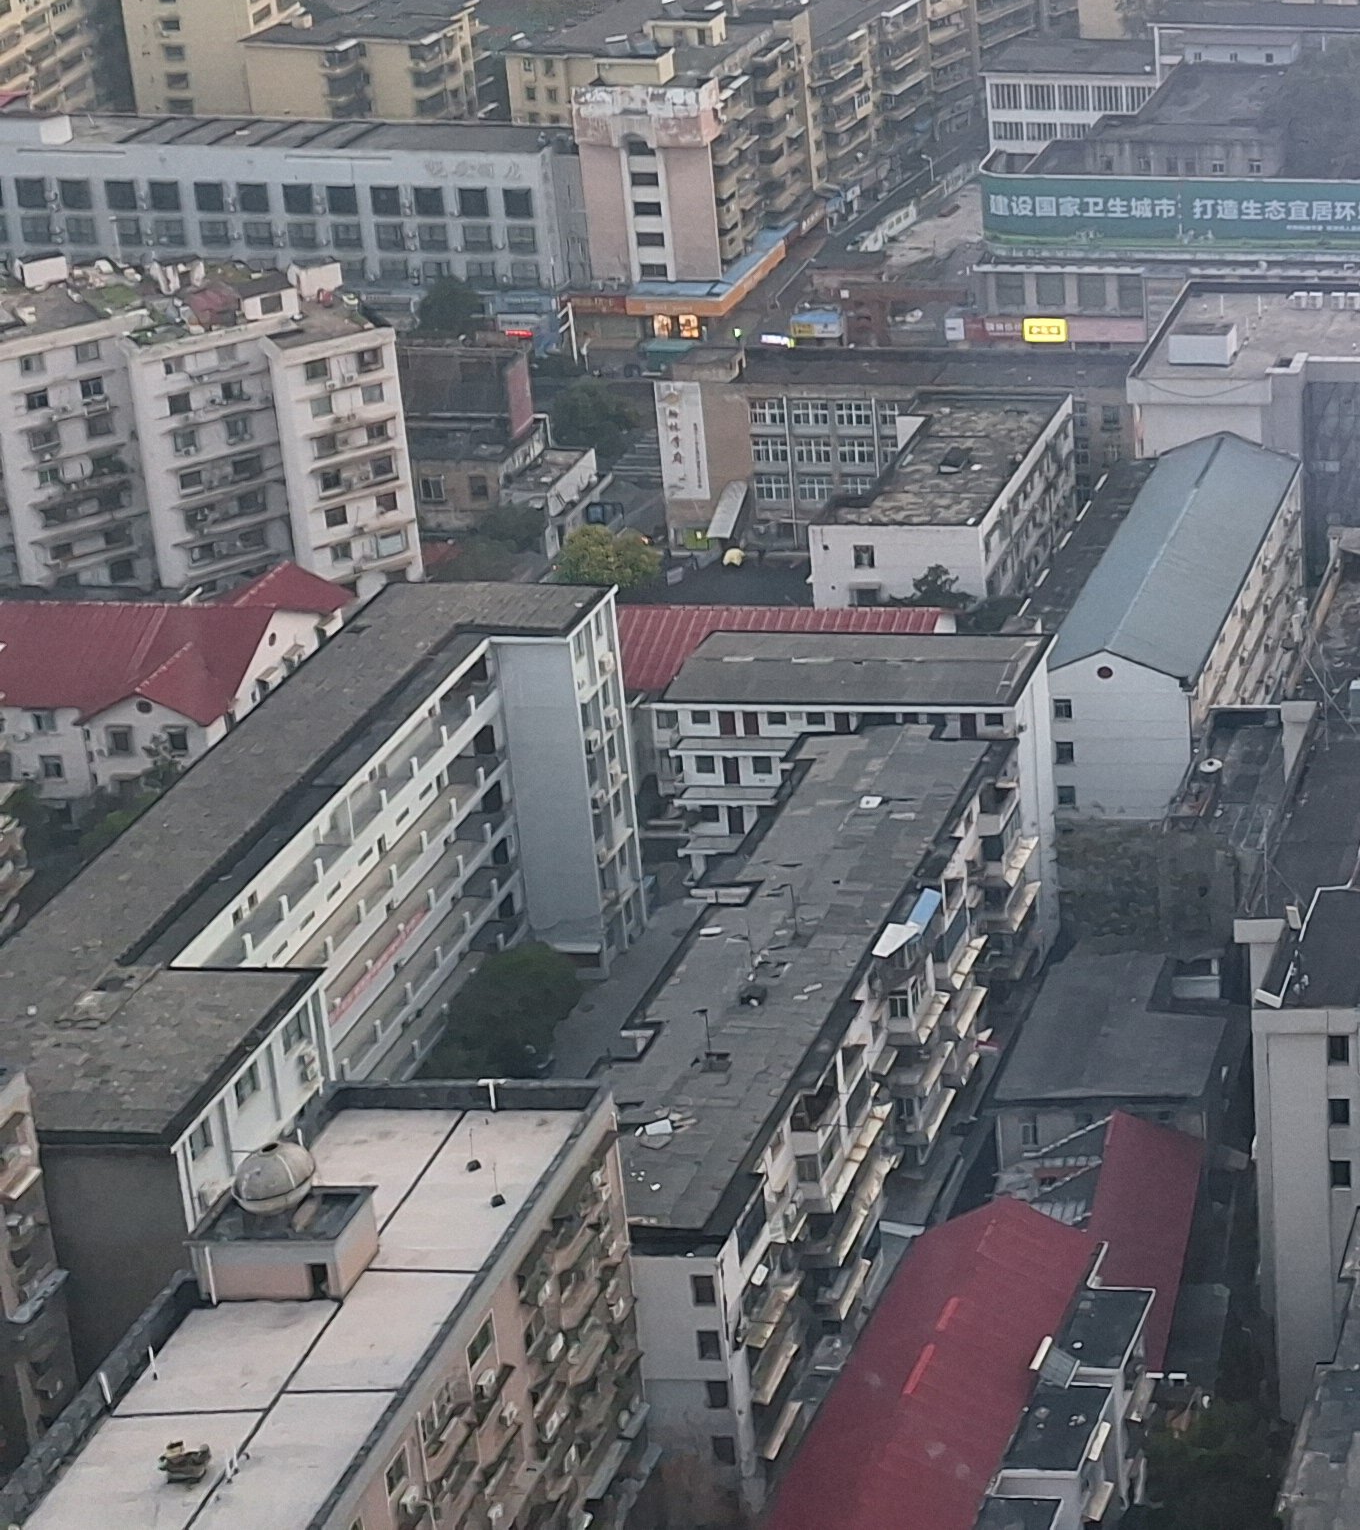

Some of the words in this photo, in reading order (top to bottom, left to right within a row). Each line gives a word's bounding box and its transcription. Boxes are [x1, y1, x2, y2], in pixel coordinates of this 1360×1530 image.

[989, 194, 1177, 219] 建设国家卫生城市
